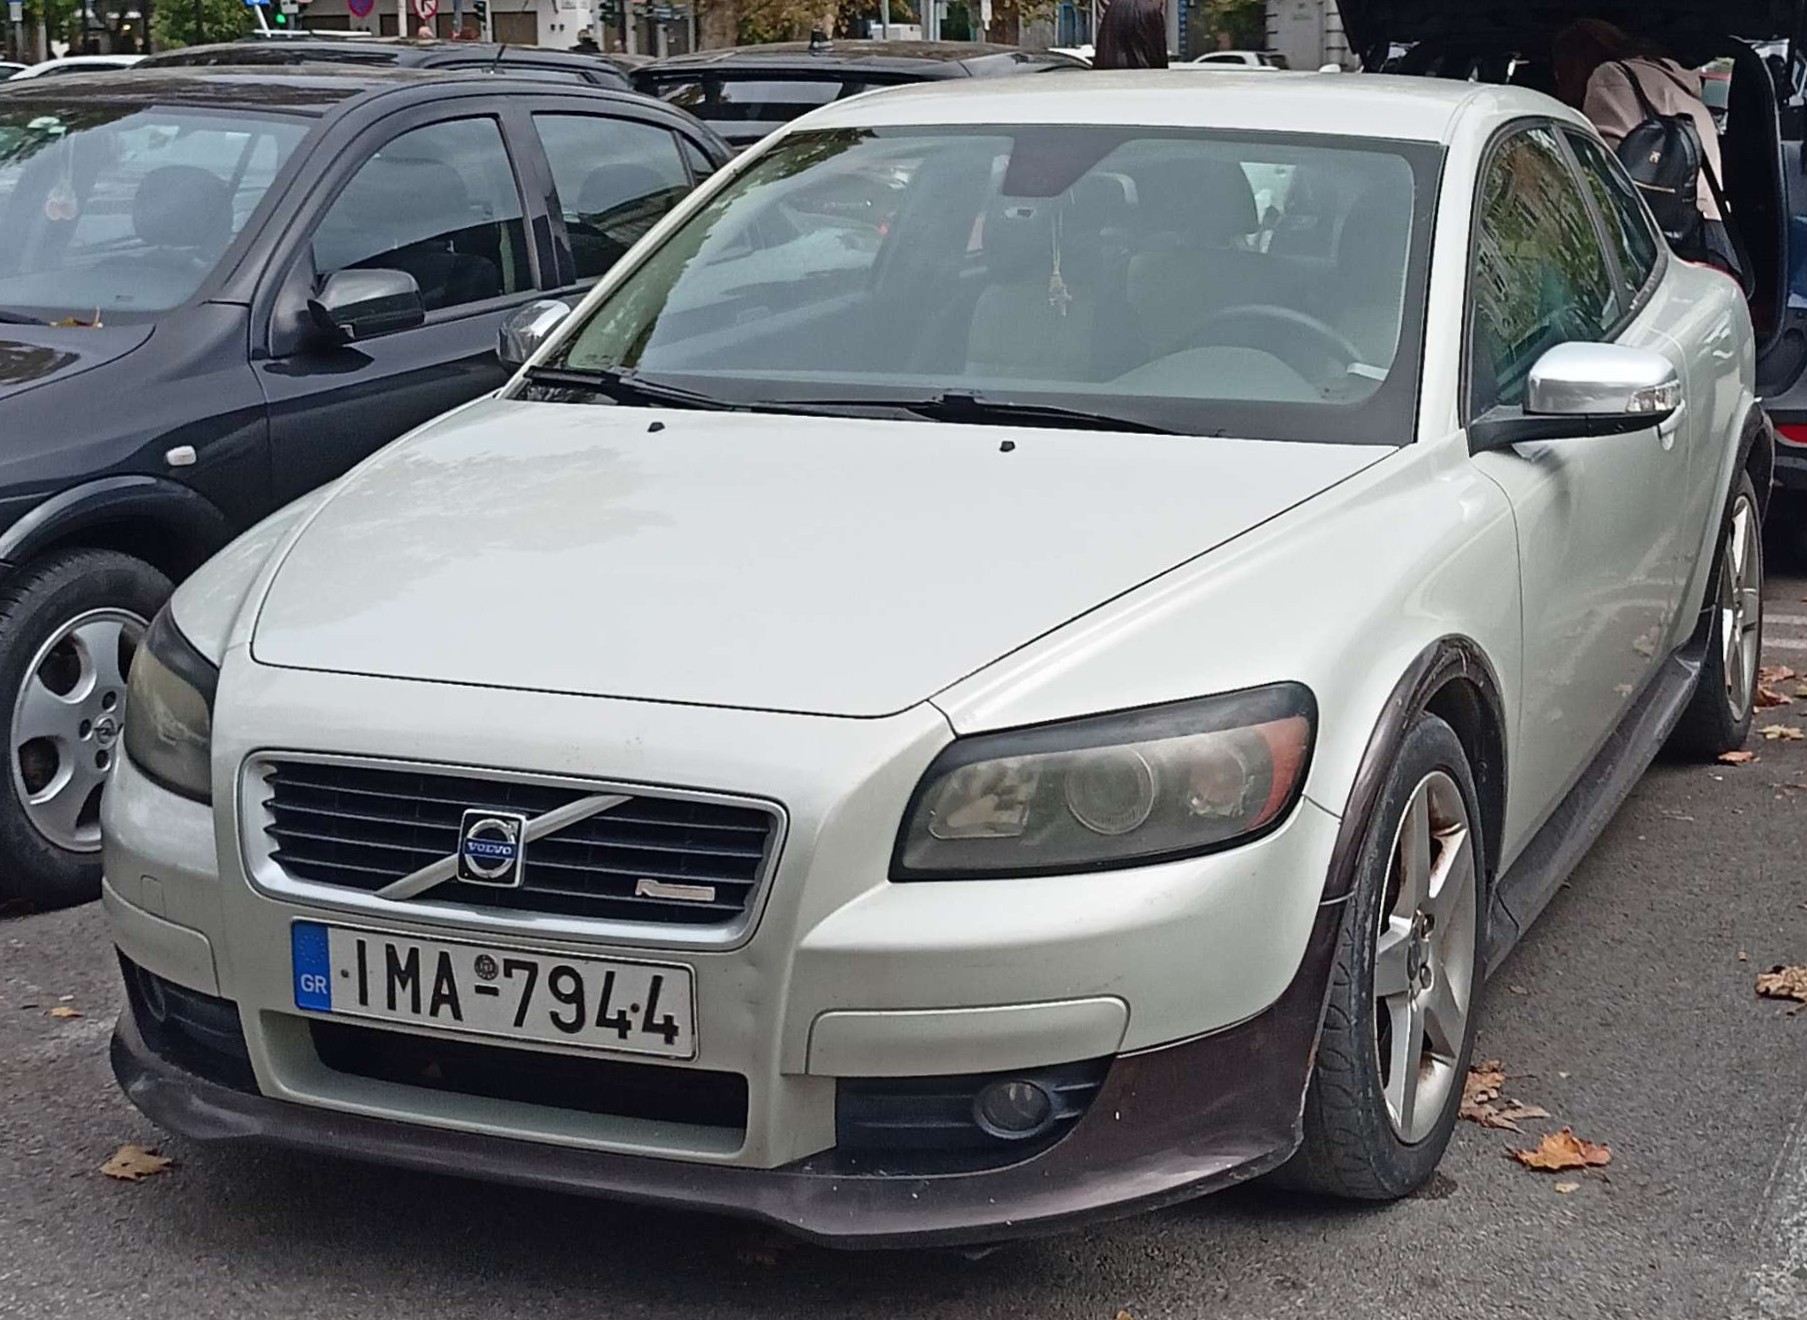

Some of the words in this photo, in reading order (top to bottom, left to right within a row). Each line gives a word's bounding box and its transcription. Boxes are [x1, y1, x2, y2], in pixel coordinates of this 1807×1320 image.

[467, 842, 512, 855] VOLVO
[300, 973, 327, 995] GR
[356, 939, 680, 1045] IMA-7944
